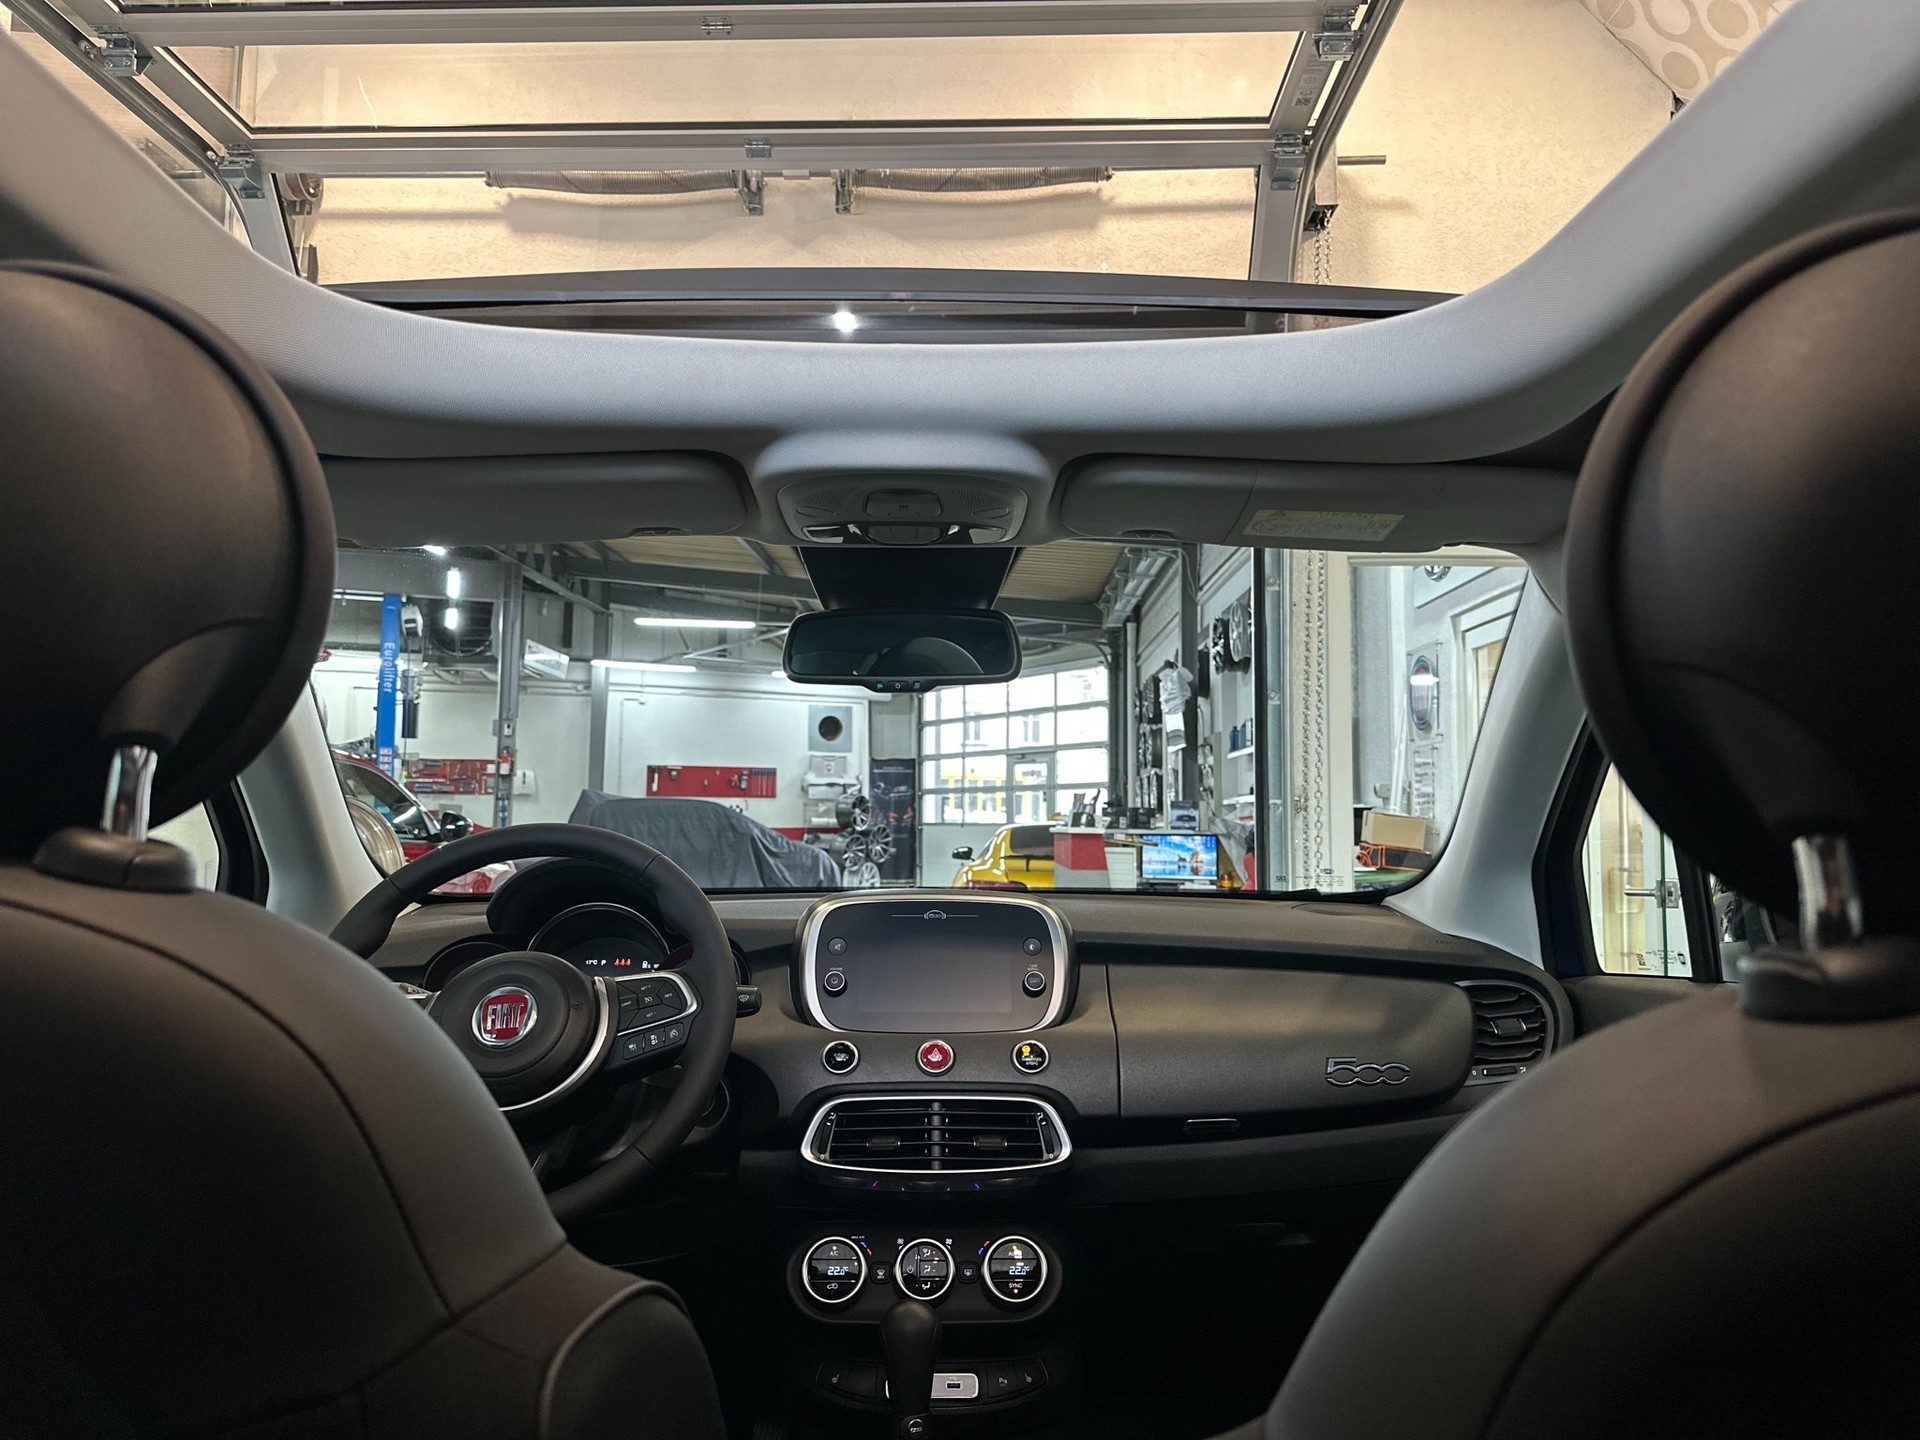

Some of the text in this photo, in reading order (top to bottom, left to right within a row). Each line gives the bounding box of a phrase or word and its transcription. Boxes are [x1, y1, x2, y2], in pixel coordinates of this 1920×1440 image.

[384, 642, 395, 693] Eurolifter
[486, 1002, 524, 1031] FIAT
[1326, 1057, 1410, 1086] 500
